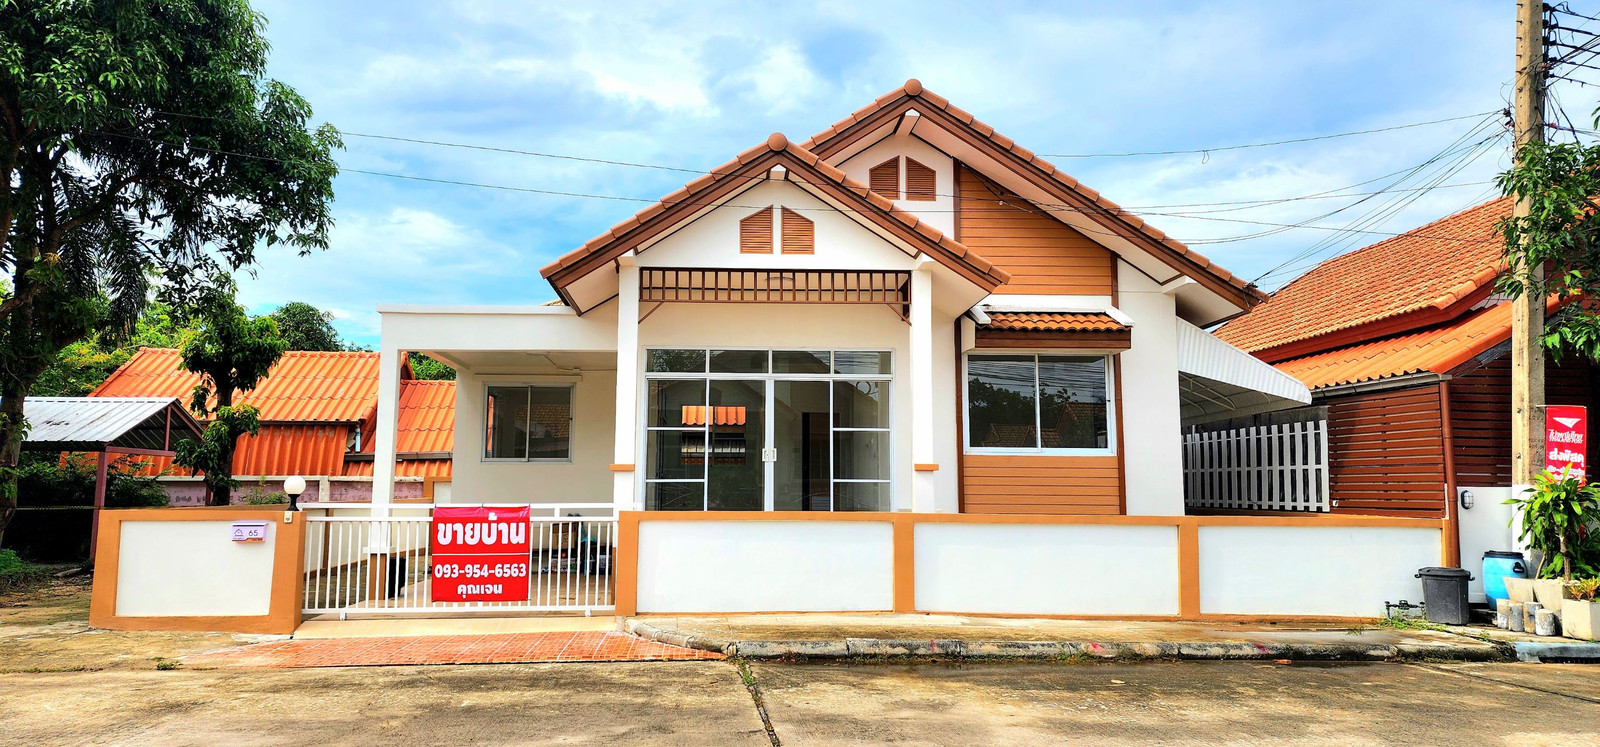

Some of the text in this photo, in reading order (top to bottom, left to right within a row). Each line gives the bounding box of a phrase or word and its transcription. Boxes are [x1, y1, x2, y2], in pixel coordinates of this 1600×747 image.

[437, 512, 526, 545] ขายบ้าน
[434, 563, 527, 578] 093-954-6563
[457, 584, 503, 599] คุณเจน
